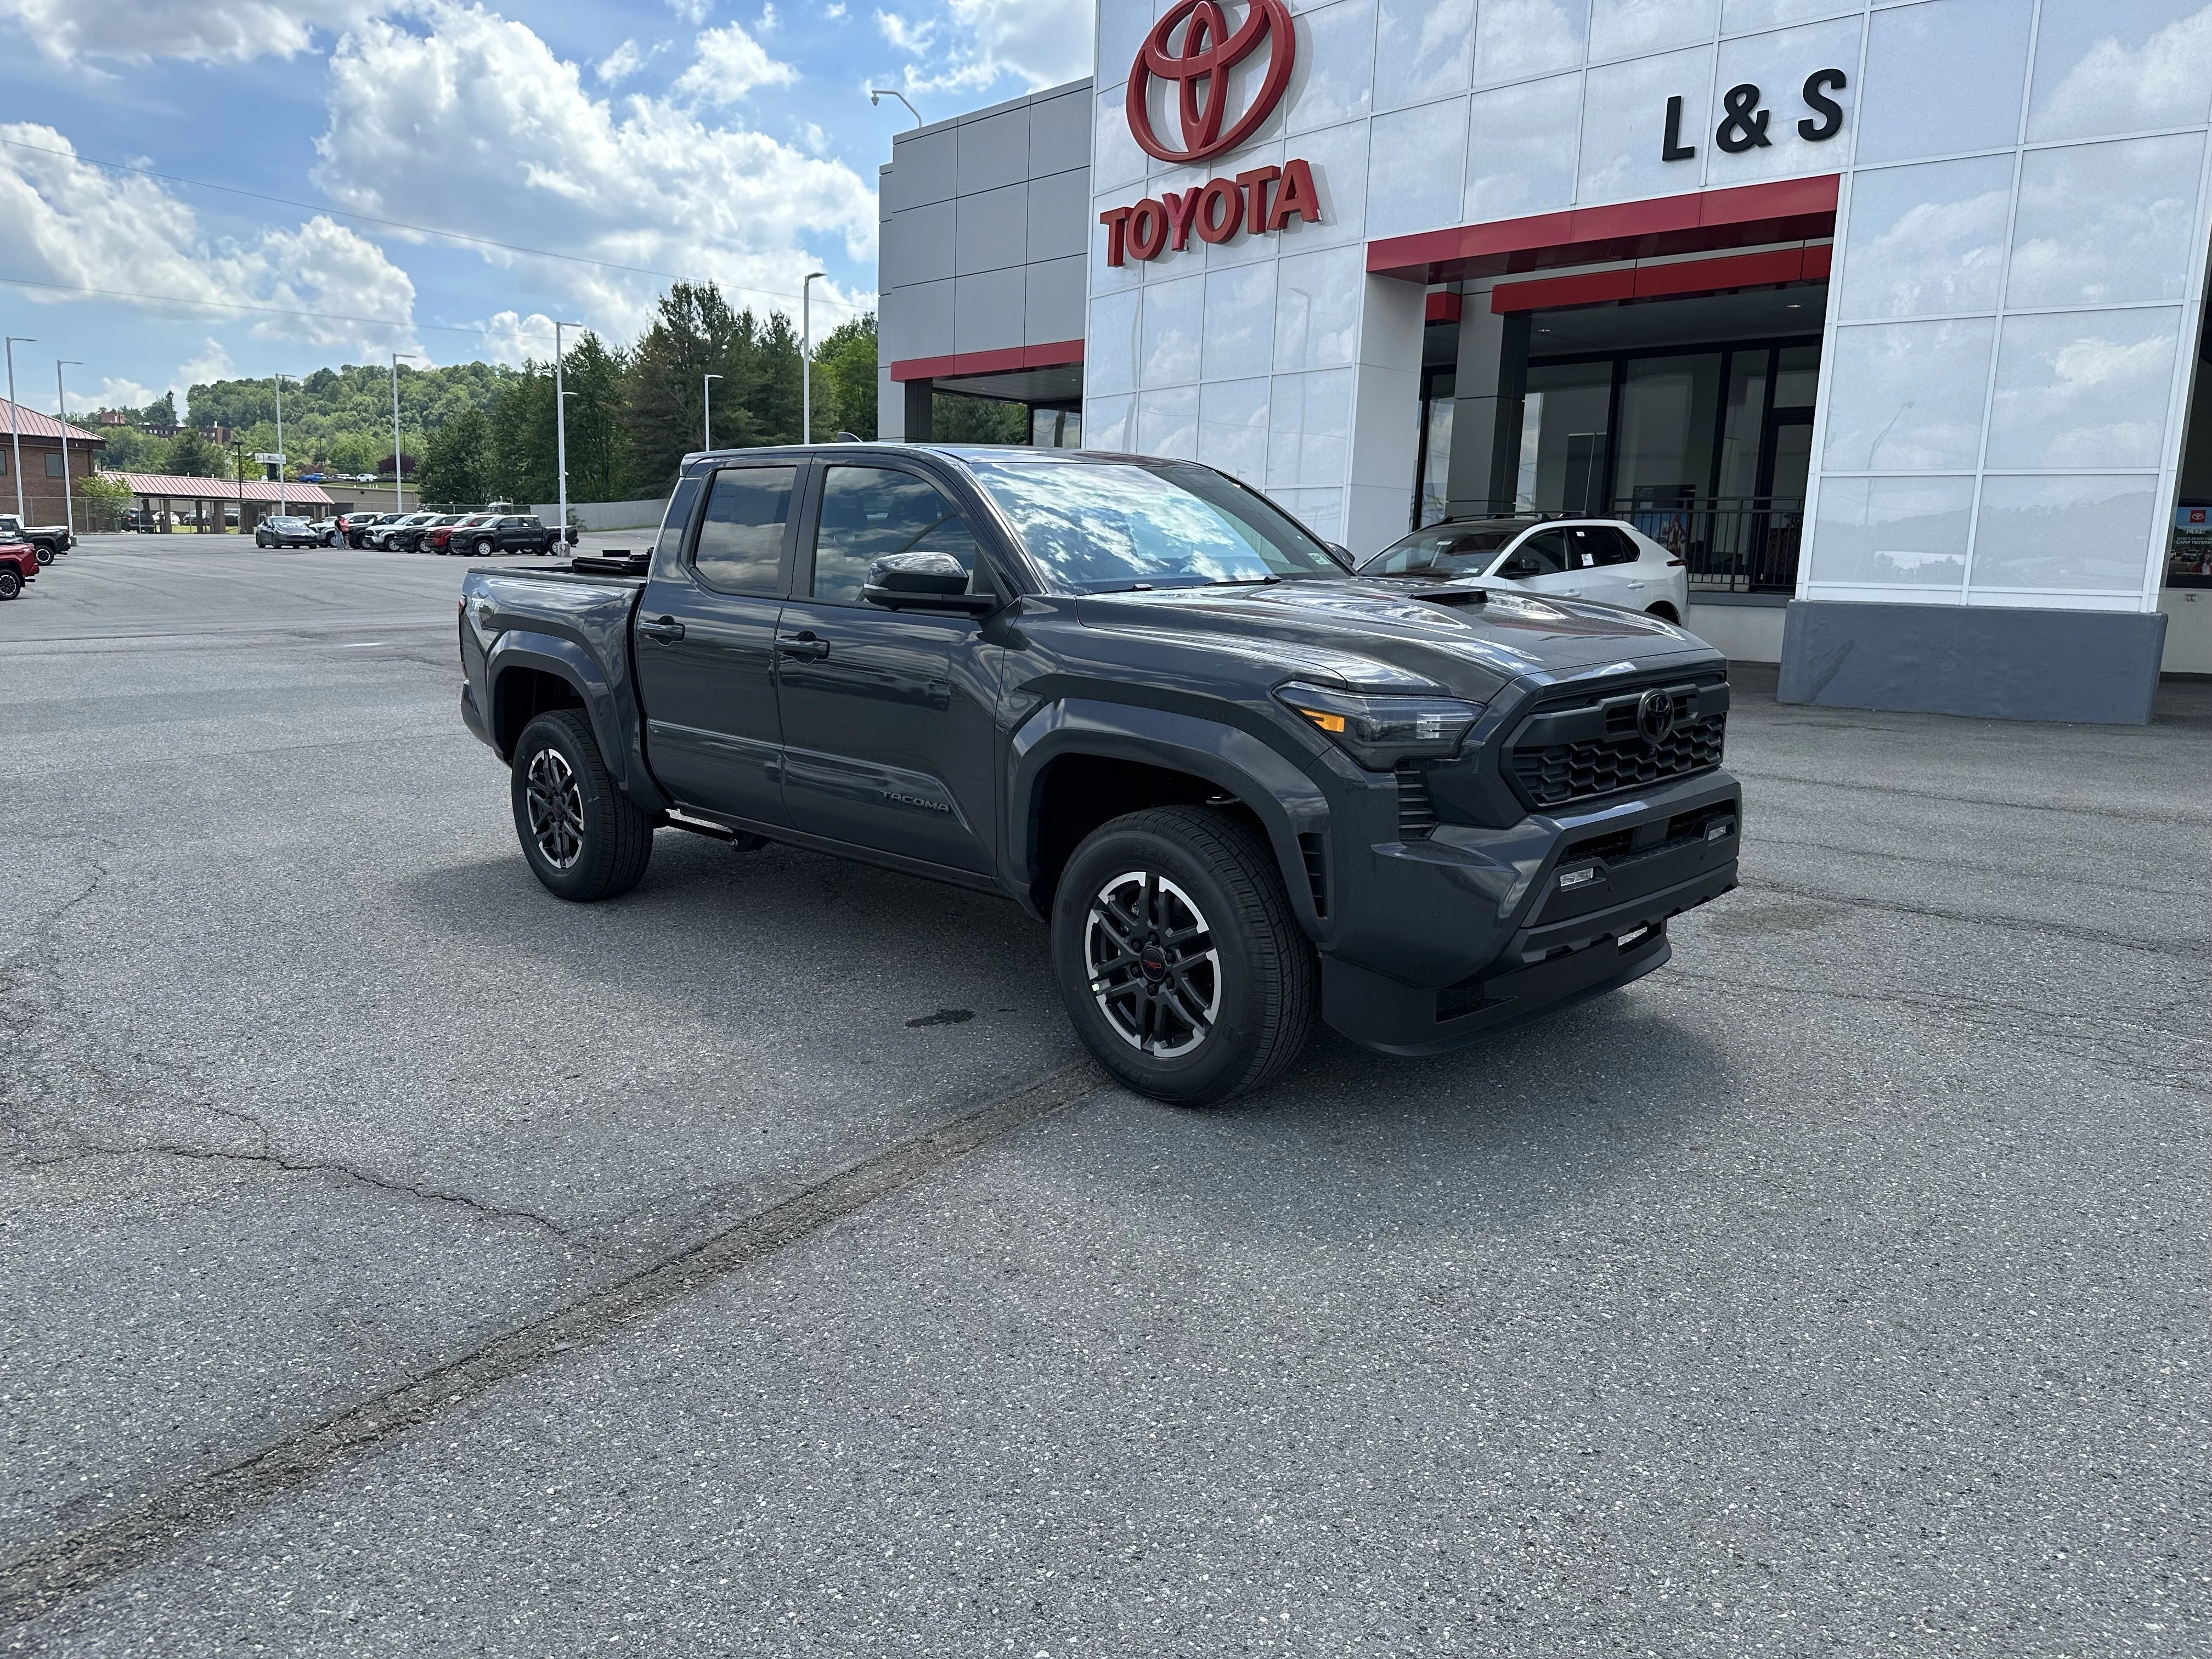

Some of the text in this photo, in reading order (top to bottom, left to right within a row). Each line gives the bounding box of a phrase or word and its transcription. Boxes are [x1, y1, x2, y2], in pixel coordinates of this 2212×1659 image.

[1662, 68, 1846, 161] L & S
[1100, 159, 1322, 268] TOYOTA
[472, 598, 484, 610] TRD
[881, 791, 950, 813] TACOMA
[1143, 960, 1161, 969] TRD
